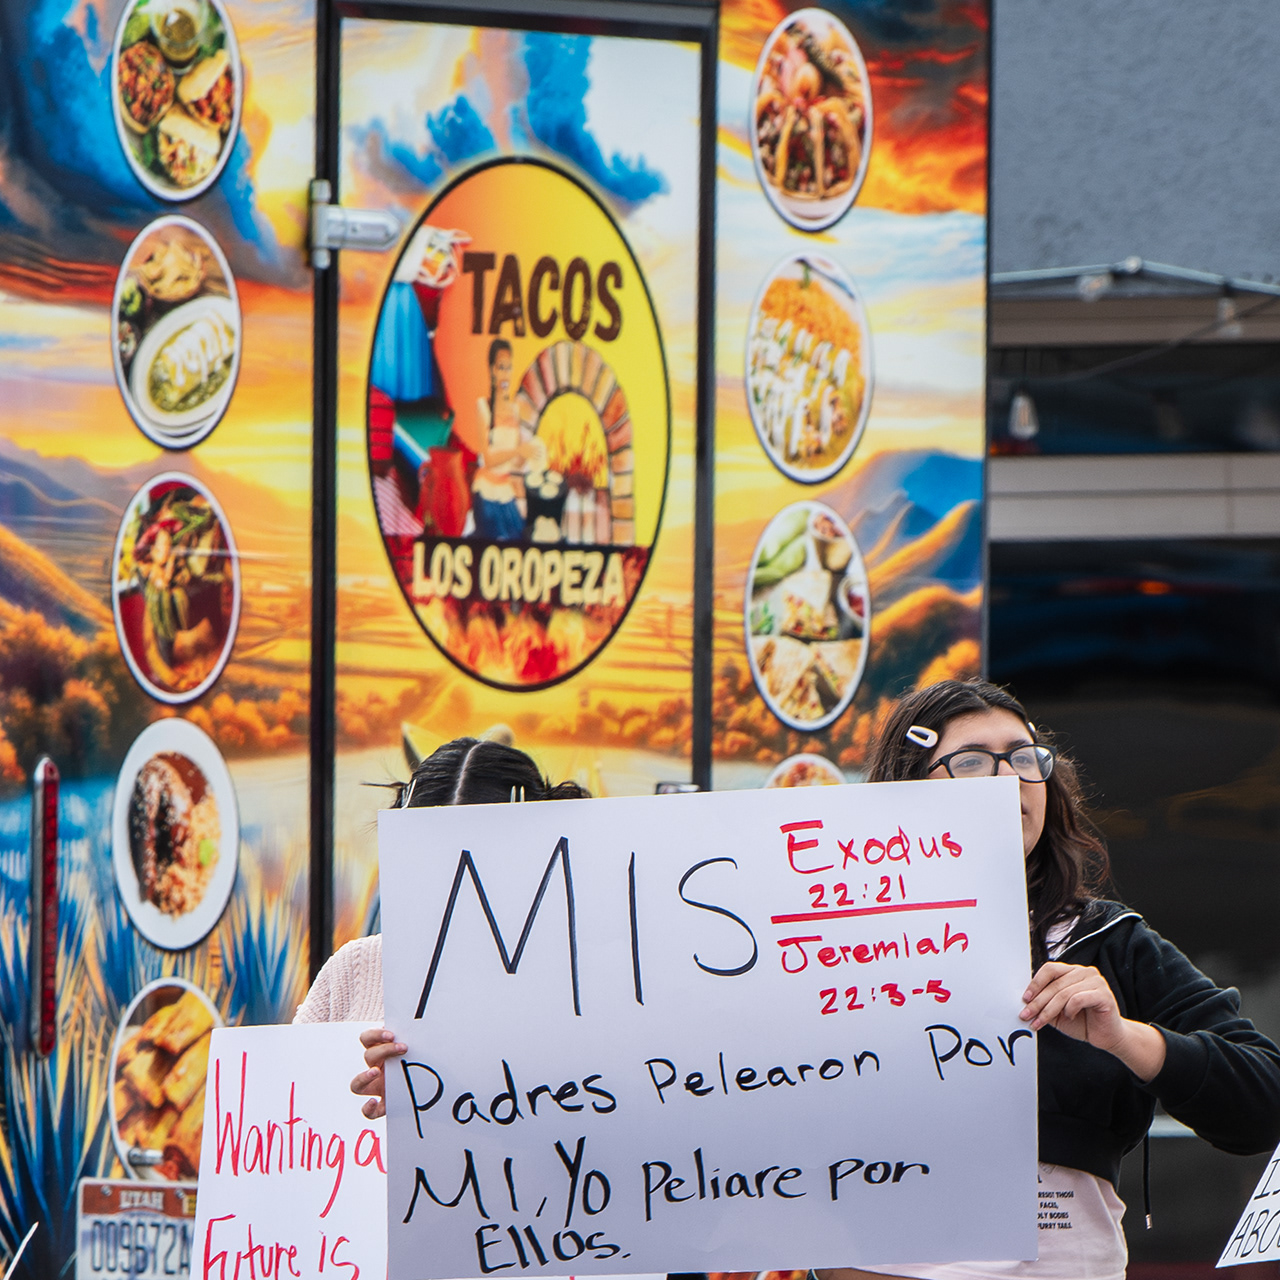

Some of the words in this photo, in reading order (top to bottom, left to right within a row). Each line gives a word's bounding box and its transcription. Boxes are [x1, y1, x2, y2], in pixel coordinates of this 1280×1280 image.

[462, 251, 624, 342] TACOS
[412, 541, 474, 600] LOS
[478, 545, 625, 606] OROPEZA
[780, 819, 964, 876] Exodus
[808, 873, 907, 909] 22:21
[413, 835, 758, 1019] MIS
[780, 923, 969, 975] Jeremiah
[401, 1057, 617, 1140] Padres
[647, 1050, 879, 1105] Pelearon
[926, 1023, 1034, 1082] Por
[215, 1051, 347, 1219] Wanting
[354, 1128, 387, 1175] a
[119, 1190, 164, 1211] UTAH
[474, 1222, 632, 1275] Ellos.
